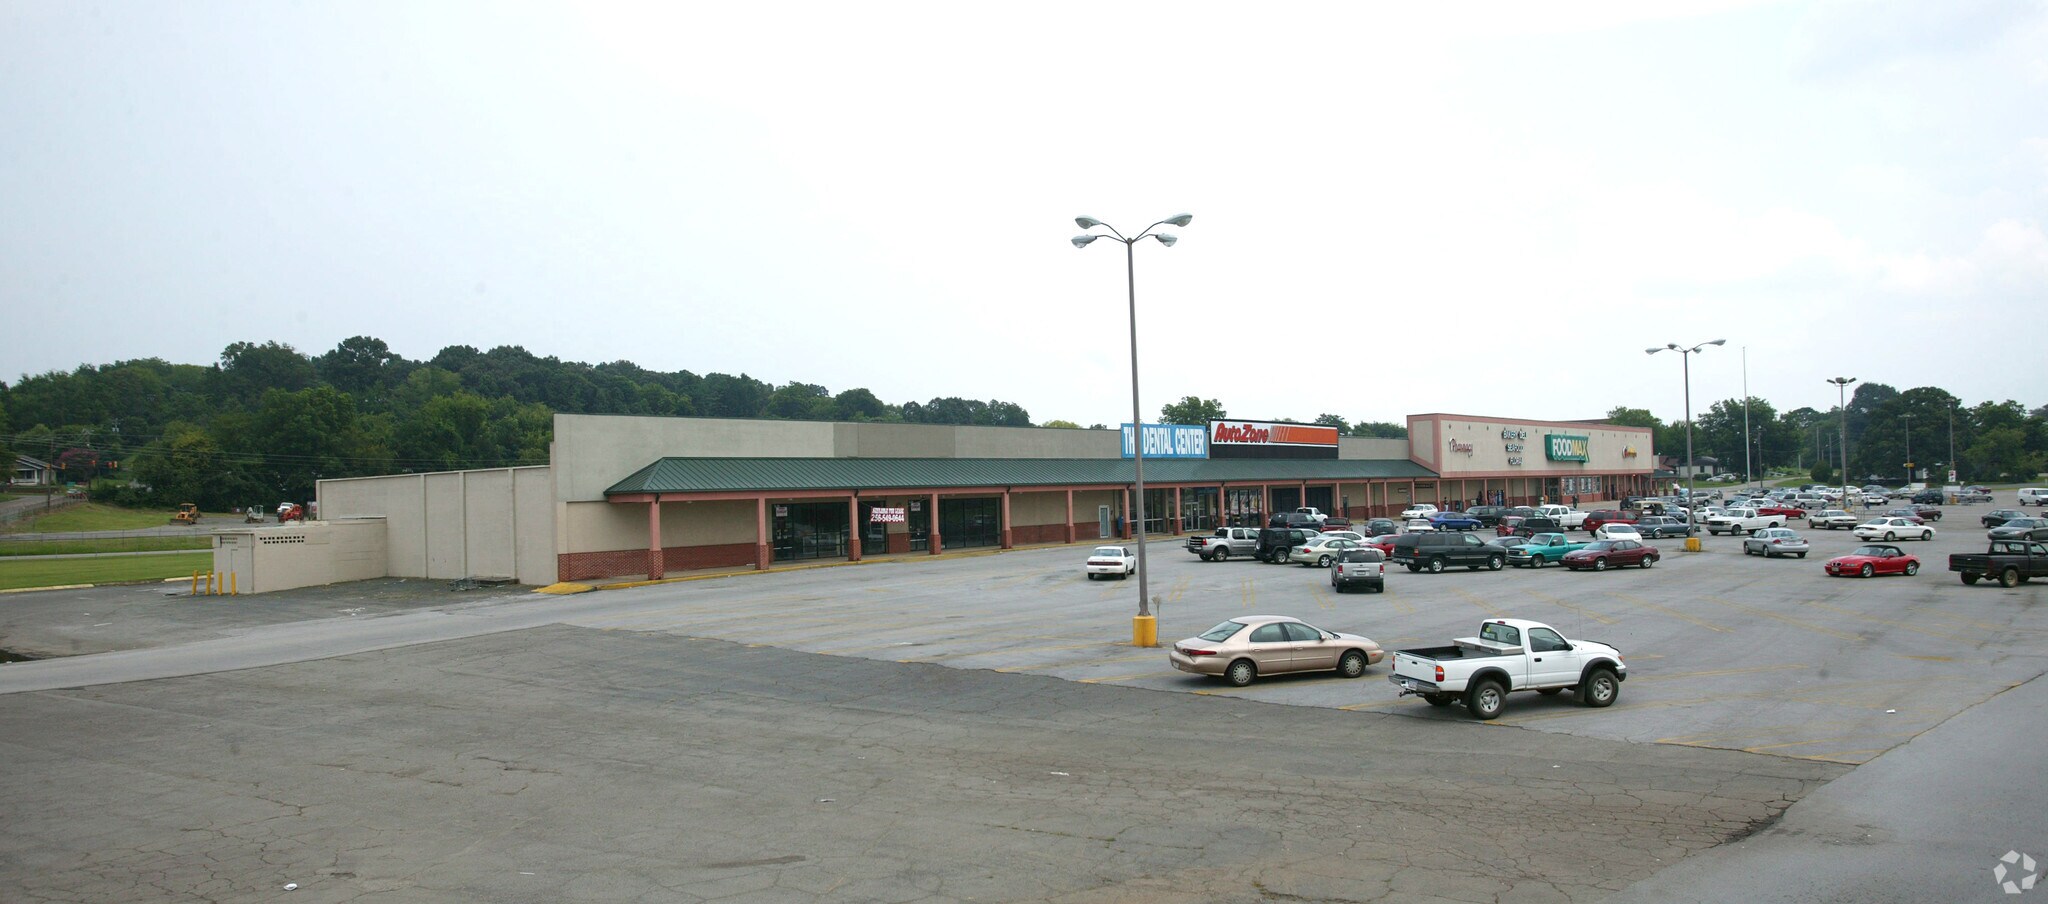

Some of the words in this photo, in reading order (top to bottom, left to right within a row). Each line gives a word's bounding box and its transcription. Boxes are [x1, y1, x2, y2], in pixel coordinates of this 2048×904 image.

[1124, 427, 1137, 455] TH
[1143, 427, 1173, 455] DENTAL
[1175, 428, 1205, 455] CENTER
[1214, 422, 1269, 444] AutoZone
[1552, 438, 1588, 458] FOODMAX
